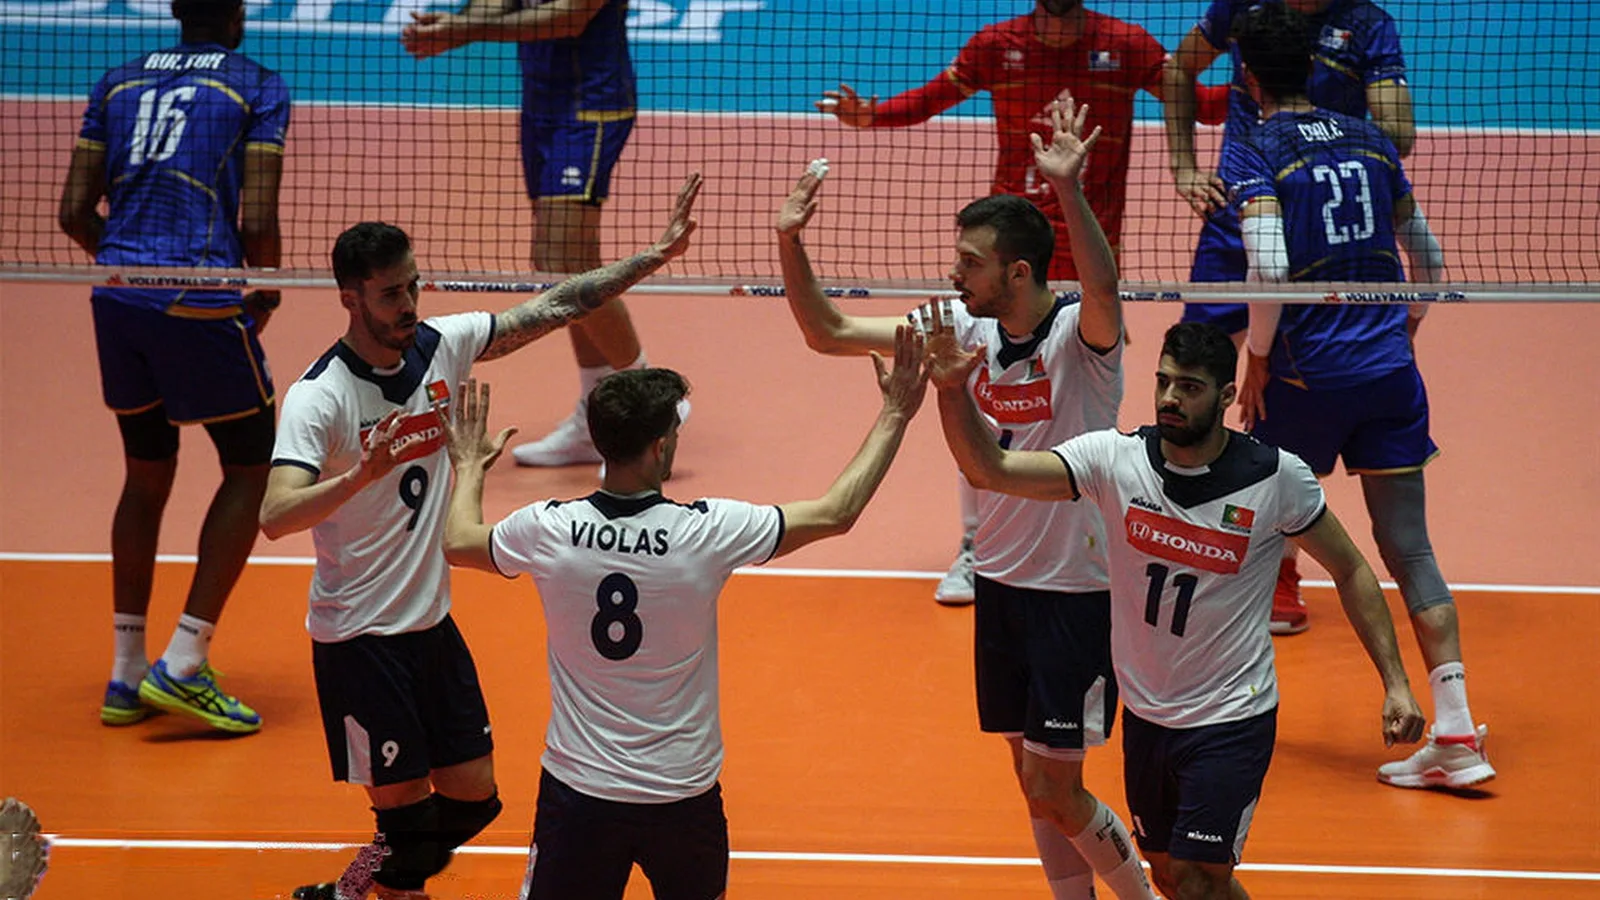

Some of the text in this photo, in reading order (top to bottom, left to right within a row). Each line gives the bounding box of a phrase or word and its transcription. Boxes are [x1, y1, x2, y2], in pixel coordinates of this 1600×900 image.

[129, 86, 198, 165] 16
[1312, 160, 1375, 245] 23
[127, 276, 199, 286] VOLLEYBALL
[1345, 291, 1416, 302] VOLLEYBALL
[398, 464, 429, 532] 9
[570, 519, 669, 556] VIOLAS
[1148, 528, 1240, 564] HONDA
[590, 571, 644, 662] 8
[1144, 561, 1199, 638] 11
[381, 739, 400, 768] 9
